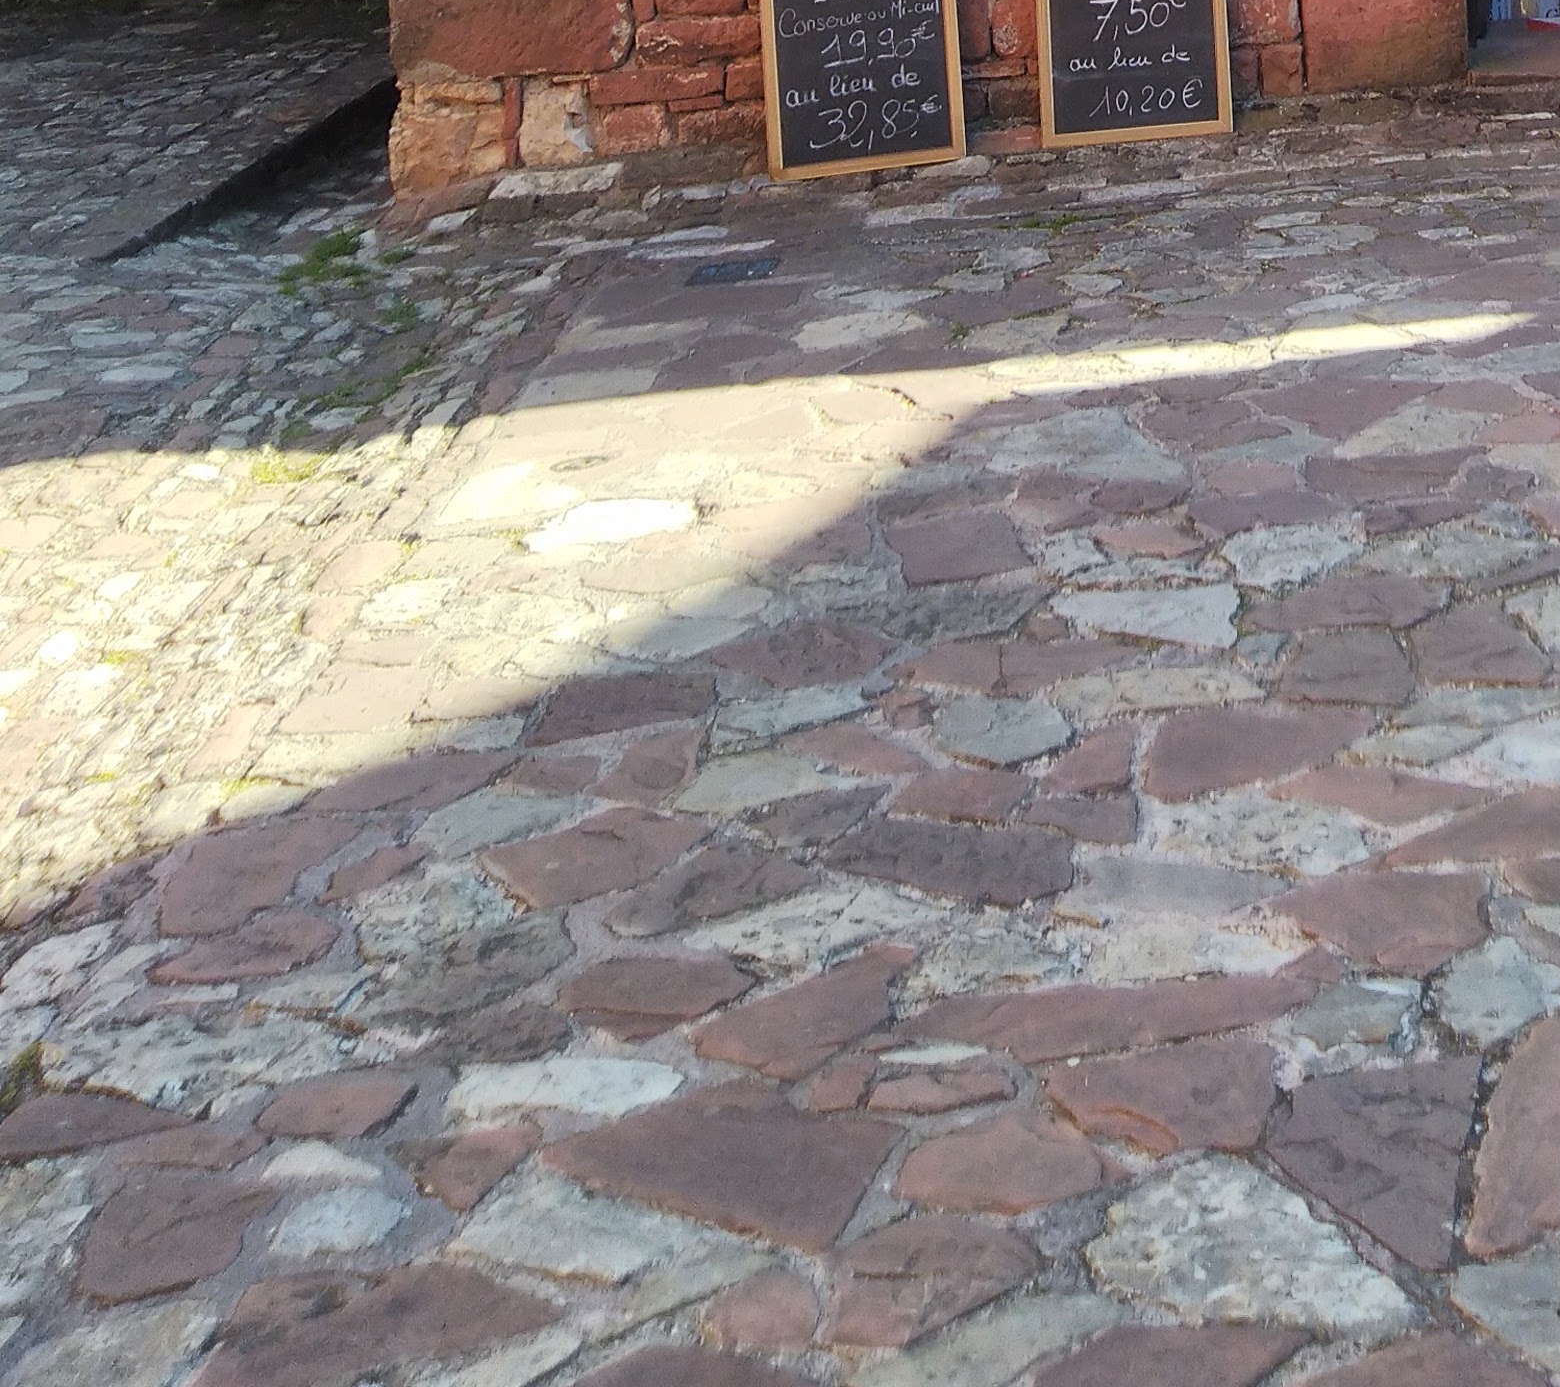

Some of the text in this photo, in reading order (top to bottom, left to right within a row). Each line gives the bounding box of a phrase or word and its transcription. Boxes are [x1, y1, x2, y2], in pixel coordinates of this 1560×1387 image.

[1069, 44, 1190, 72] au lieu de
[786, 64, 921, 108] au lieu de
